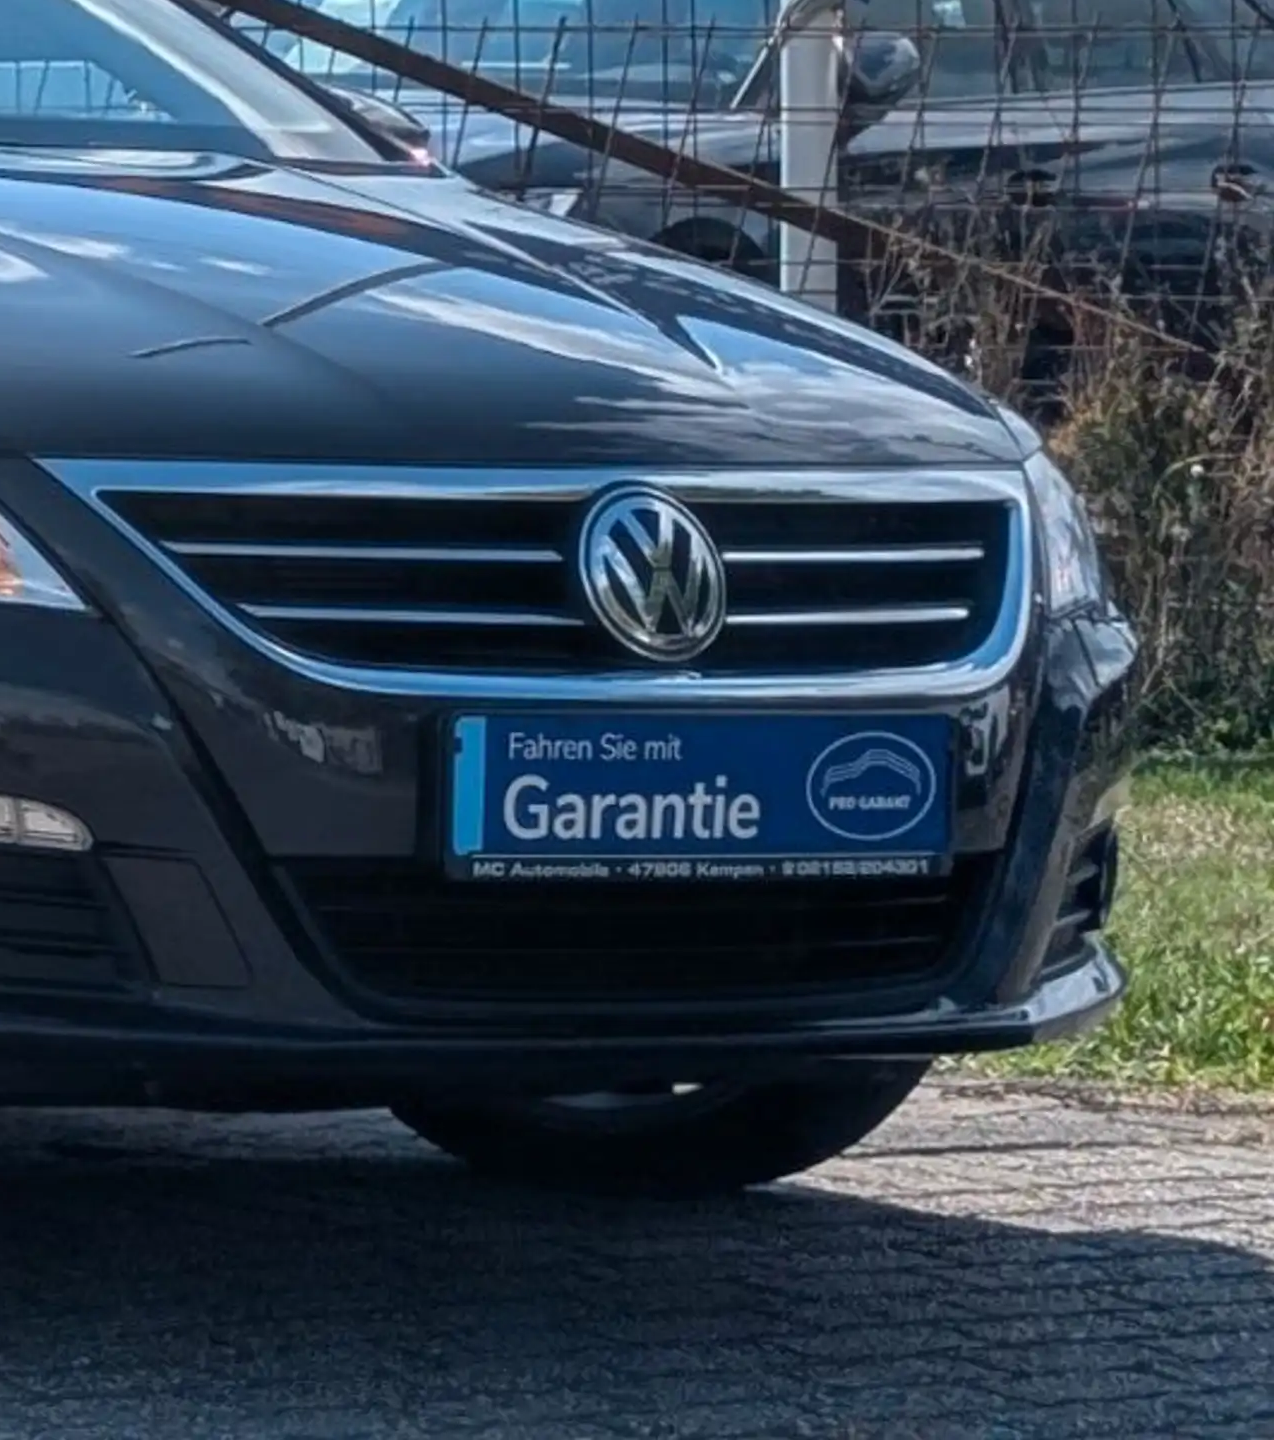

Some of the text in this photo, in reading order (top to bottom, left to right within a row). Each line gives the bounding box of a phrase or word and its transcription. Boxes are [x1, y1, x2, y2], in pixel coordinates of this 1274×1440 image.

[508, 731, 682, 761] Fahren Sie mit
[502, 773, 761, 841] Garantie
[509, 861, 610, 878] Automobile
